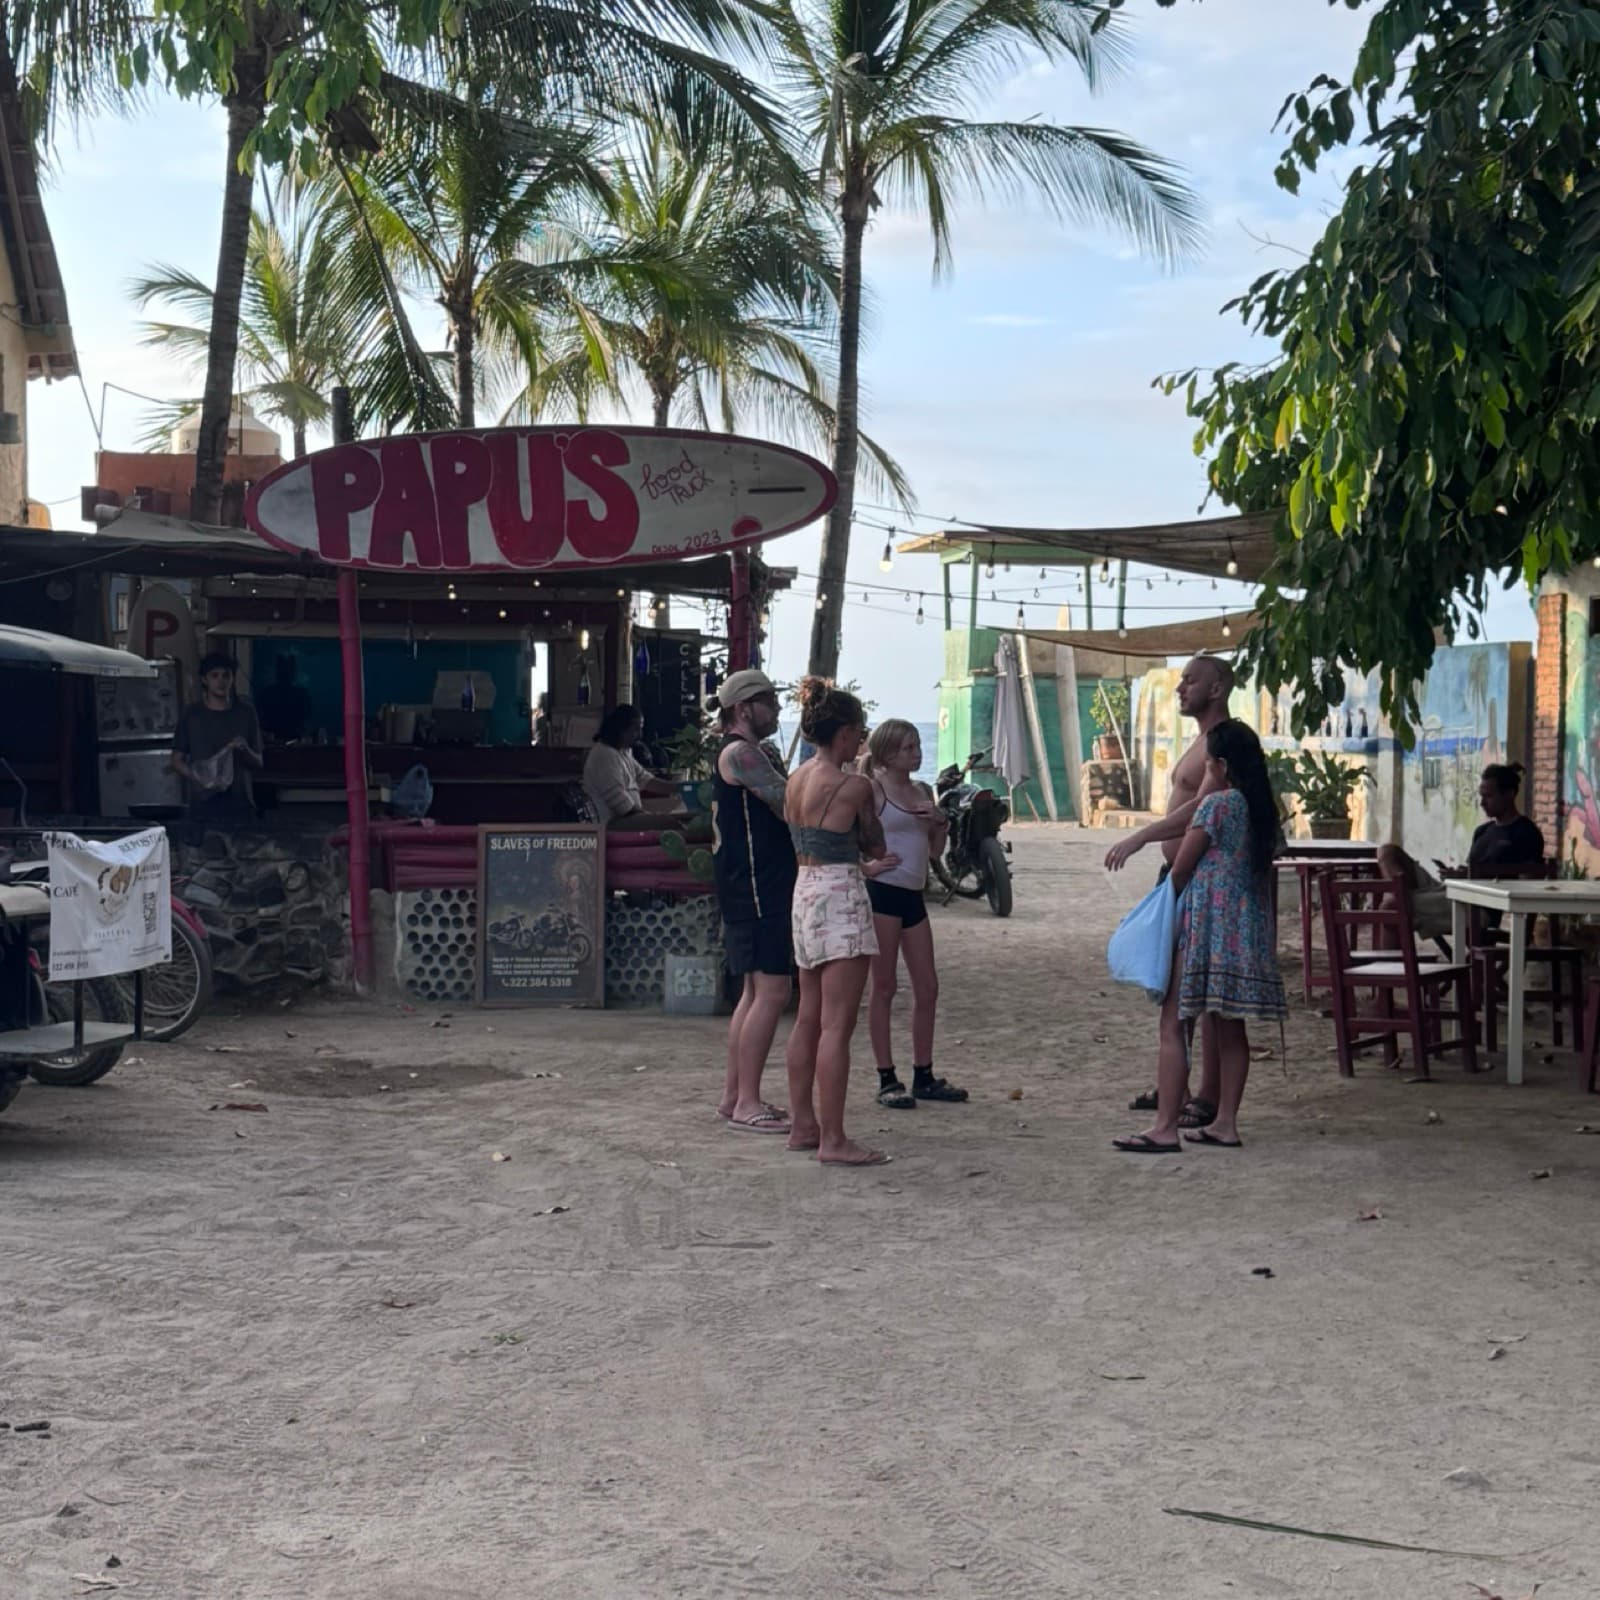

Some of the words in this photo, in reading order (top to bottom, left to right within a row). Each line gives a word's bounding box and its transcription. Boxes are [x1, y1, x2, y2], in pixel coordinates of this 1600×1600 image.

[683, 529, 721, 551] 2023
[145, 609, 180, 660] P
[490, 837, 530, 850] SLAVES
[533, 837, 545, 849] OF
[547, 837, 597, 849] FREEDOM
